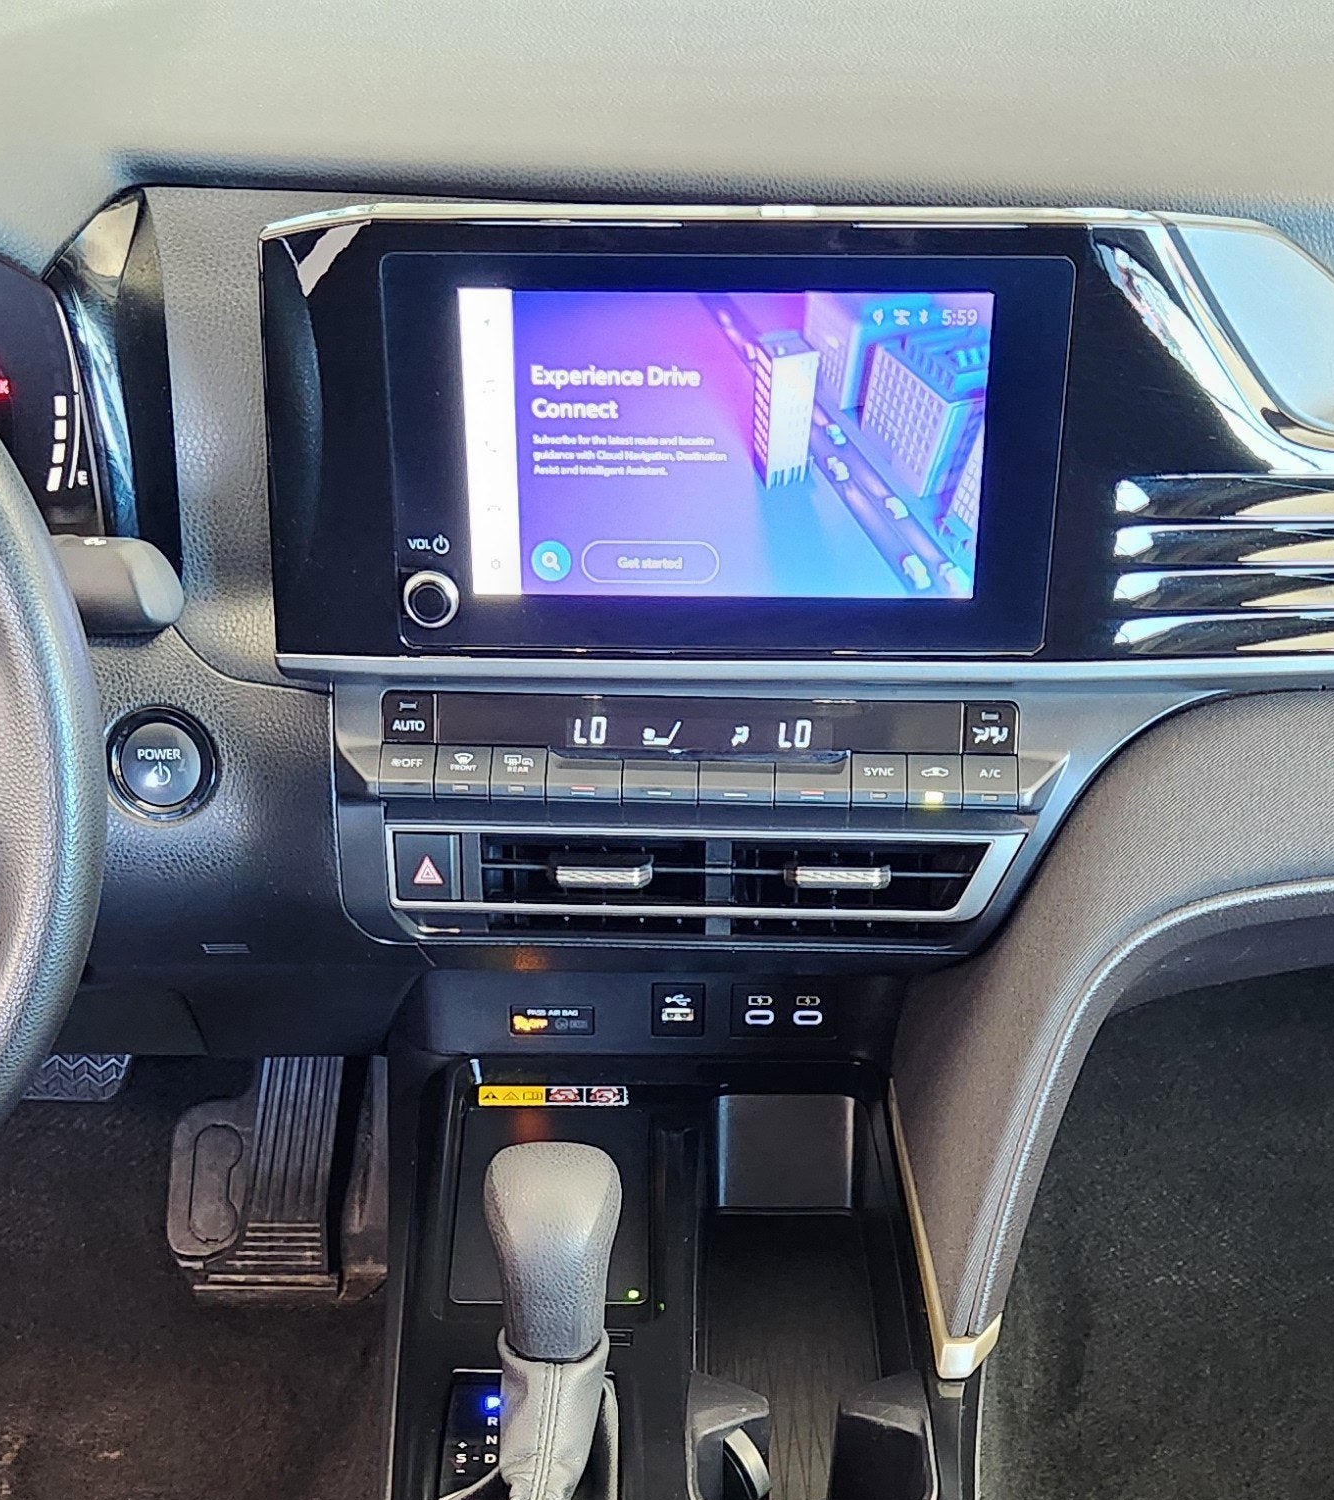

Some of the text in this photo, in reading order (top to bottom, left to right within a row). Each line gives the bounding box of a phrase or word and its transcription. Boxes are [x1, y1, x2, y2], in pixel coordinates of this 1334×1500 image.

[941, 309, 978, 327] 5:59
[530, 365, 701, 390] Experience Drive
[531, 398, 619, 419] Connect
[532, 434, 714, 446] Subscribe for the latest route and location
[533, 450, 727, 463] guidance with Cloud Navigation, Destination
[534, 465, 668, 477] Assist and Intelligent Assistant.
[77, 471, 88, 486] E
[407, 538, 432, 551] VOL
[617, 557, 683, 570] Get started
[392, 719, 426, 732] AUTO
[573, 716, 607, 745] LO
[778, 719, 812, 748] LO
[137, 747, 181, 761] POWER
[401, 758, 423, 768] OFF
[449, 764, 477, 772] FRONT
[863, 767, 895, 777] SYNC
[979, 768, 1001, 778] A/C
[526, 1009, 579, 1017] PASS AIR BAG
[487, 1416, 498, 1426] R
[485, 1435, 498, 1445] N
[455, 1453, 497, 1464] S D
